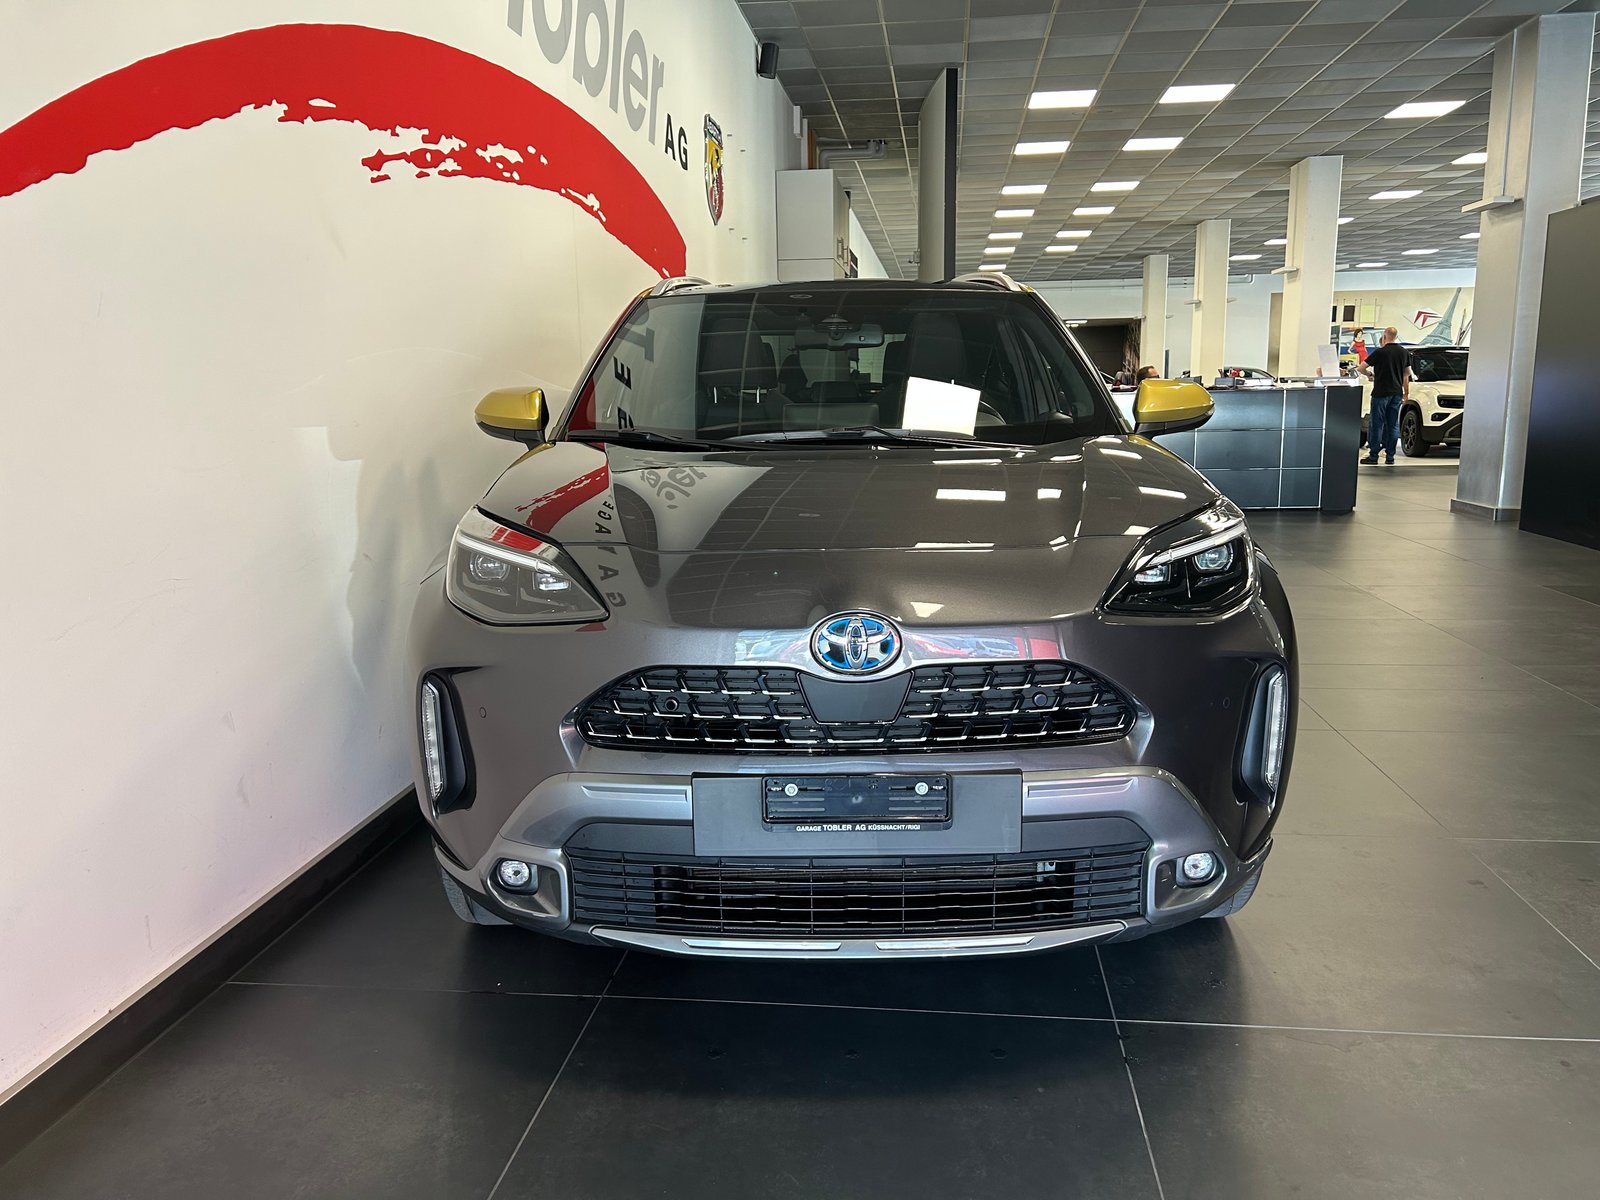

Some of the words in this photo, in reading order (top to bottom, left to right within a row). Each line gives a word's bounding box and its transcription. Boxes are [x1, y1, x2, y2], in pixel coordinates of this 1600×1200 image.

[507, 0, 665, 146] obler
[664, 112, 688, 171] AG
[868, 823, 921, 831] KÜSSNACHT/RIGI
